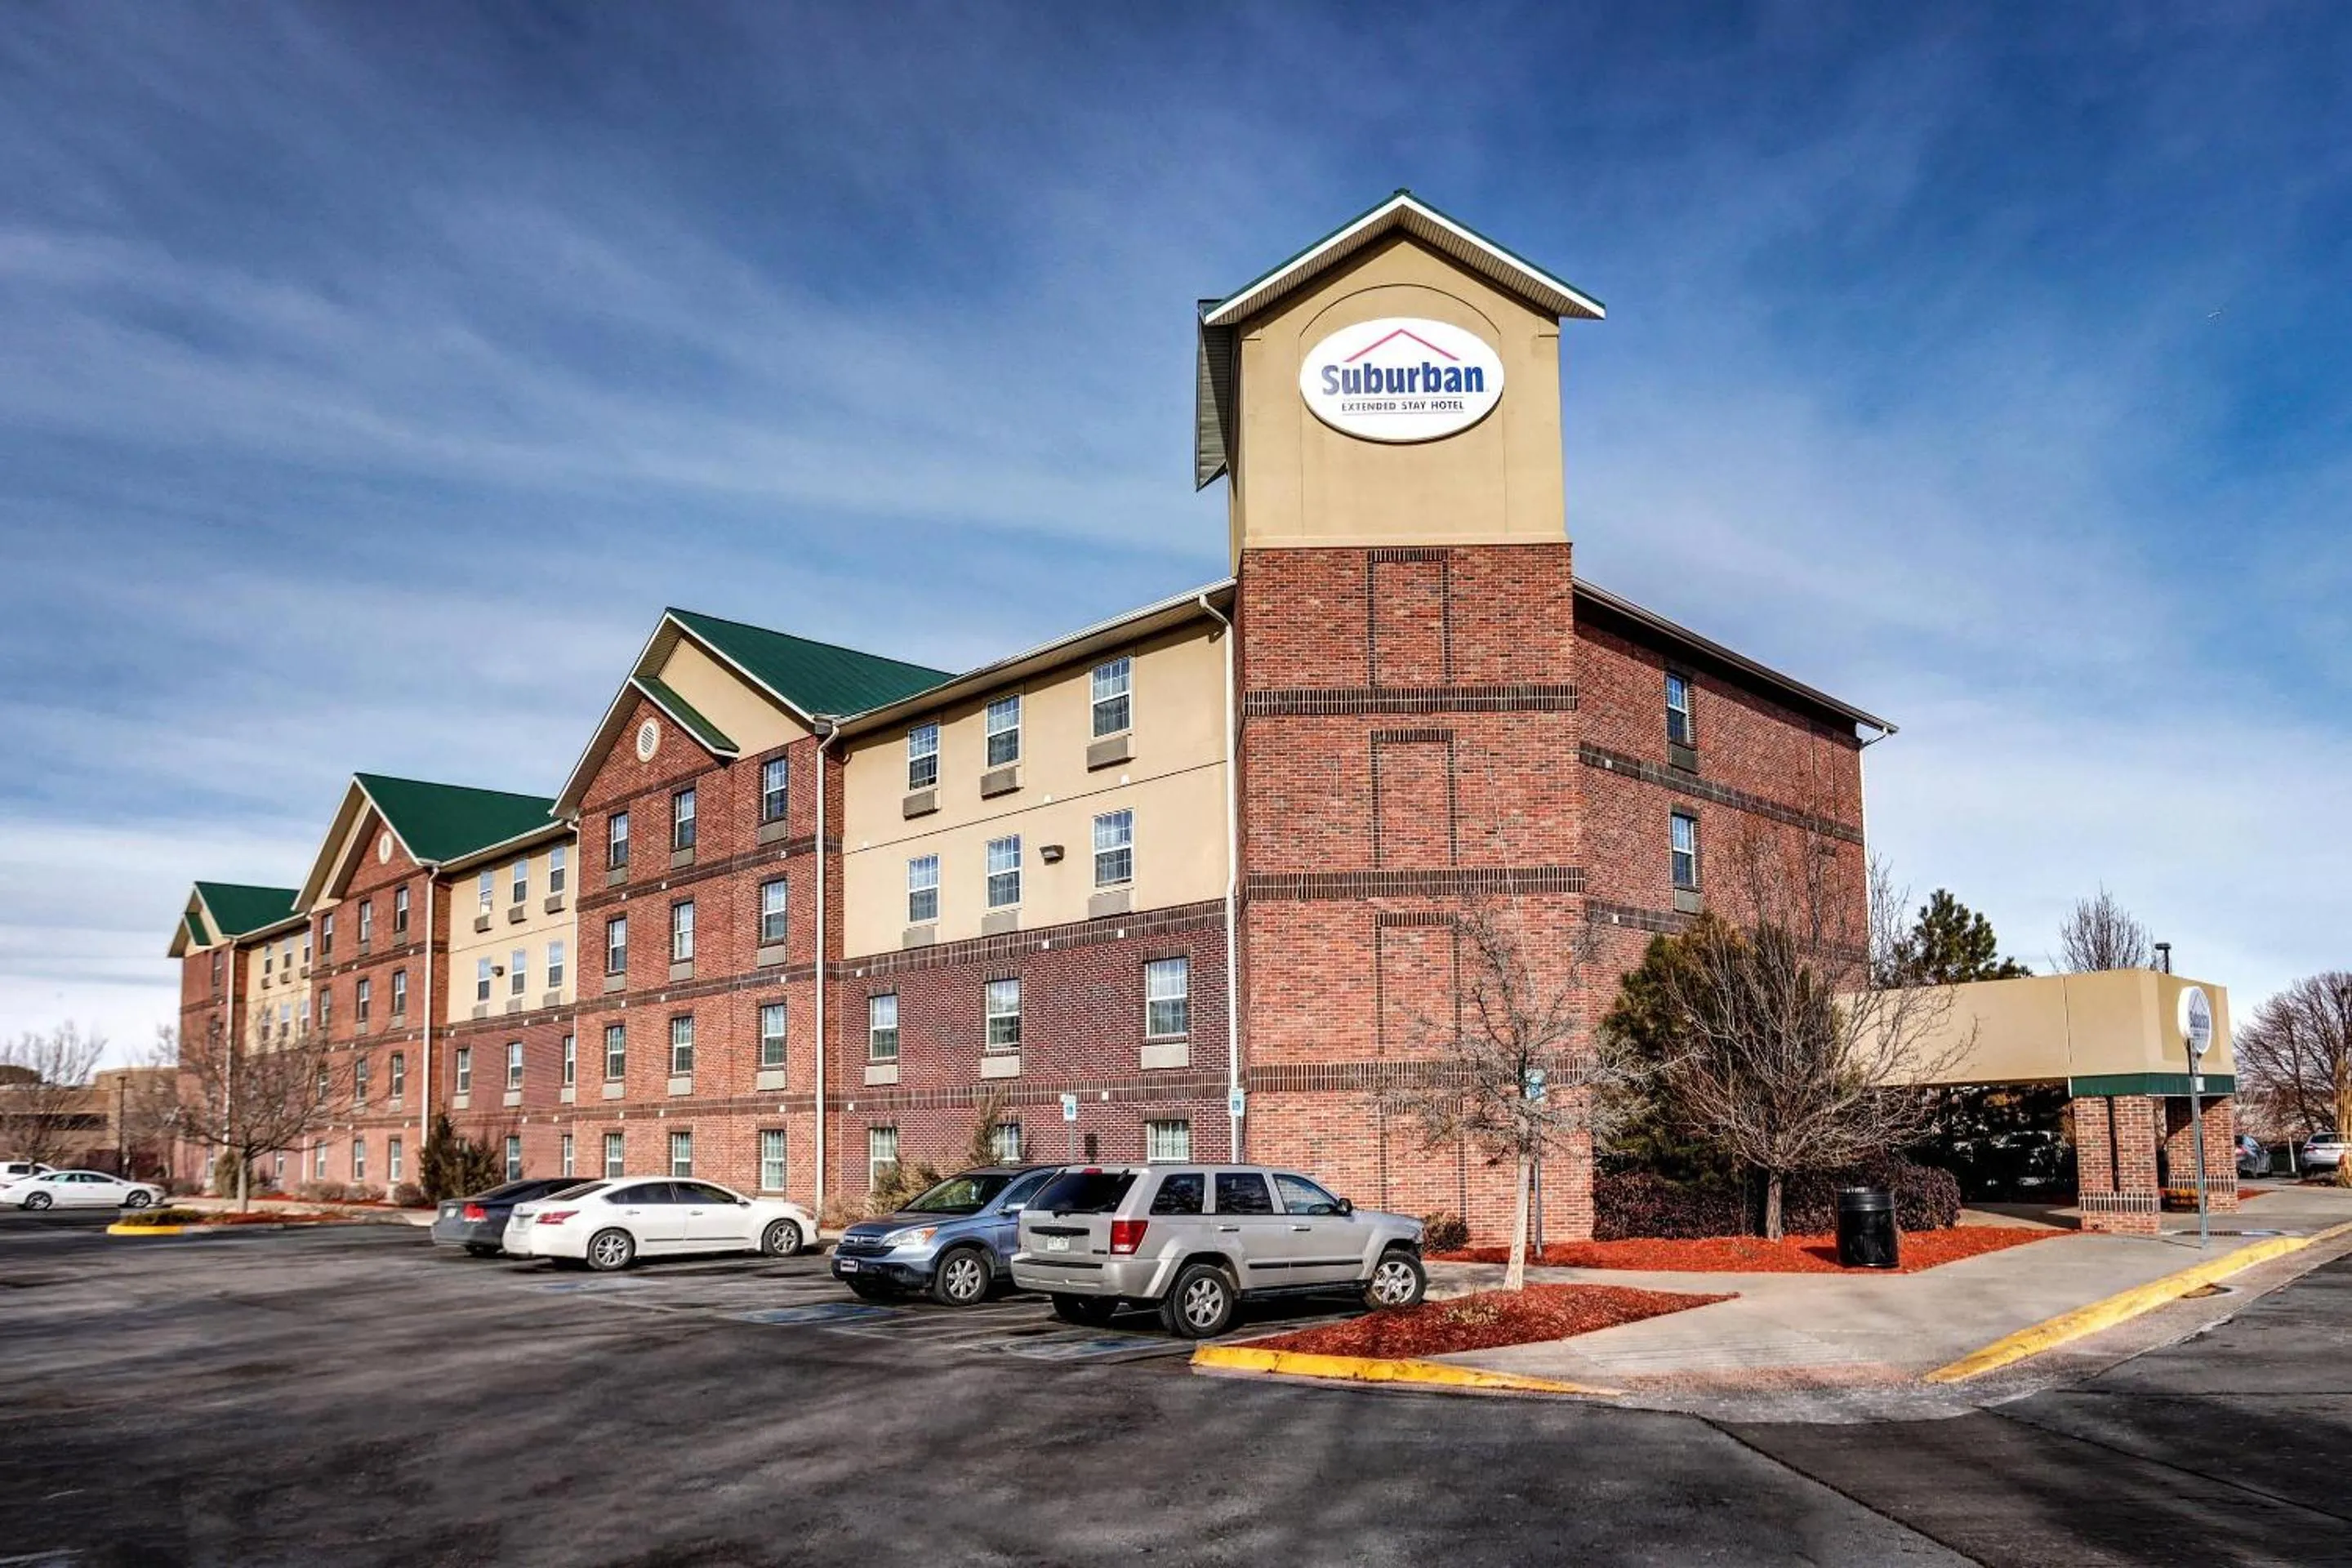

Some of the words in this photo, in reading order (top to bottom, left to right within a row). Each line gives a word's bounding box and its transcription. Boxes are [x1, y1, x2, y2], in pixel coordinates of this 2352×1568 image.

[1321, 362, 1484, 395] Suburban
[1341, 402, 1396, 412] EXTENDED
[1401, 401, 1426, 410] STAY
[1431, 400, 1464, 410] HOTEL
